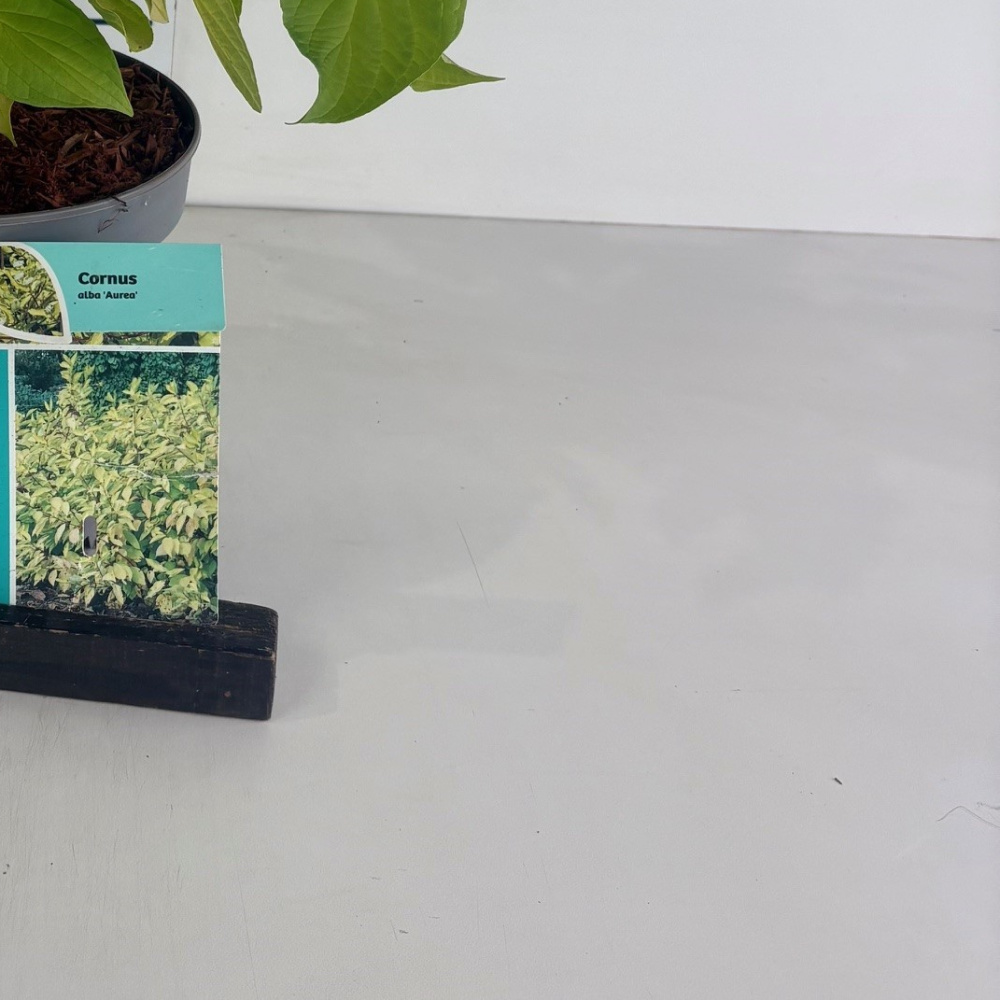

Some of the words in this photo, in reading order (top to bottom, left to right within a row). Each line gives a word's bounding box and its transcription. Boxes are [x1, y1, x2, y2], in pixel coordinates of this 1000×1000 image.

[78, 272, 138, 285] Cornus
[78, 291, 101, 299] alba
[103, 291, 138, 299] 'Aurea'
